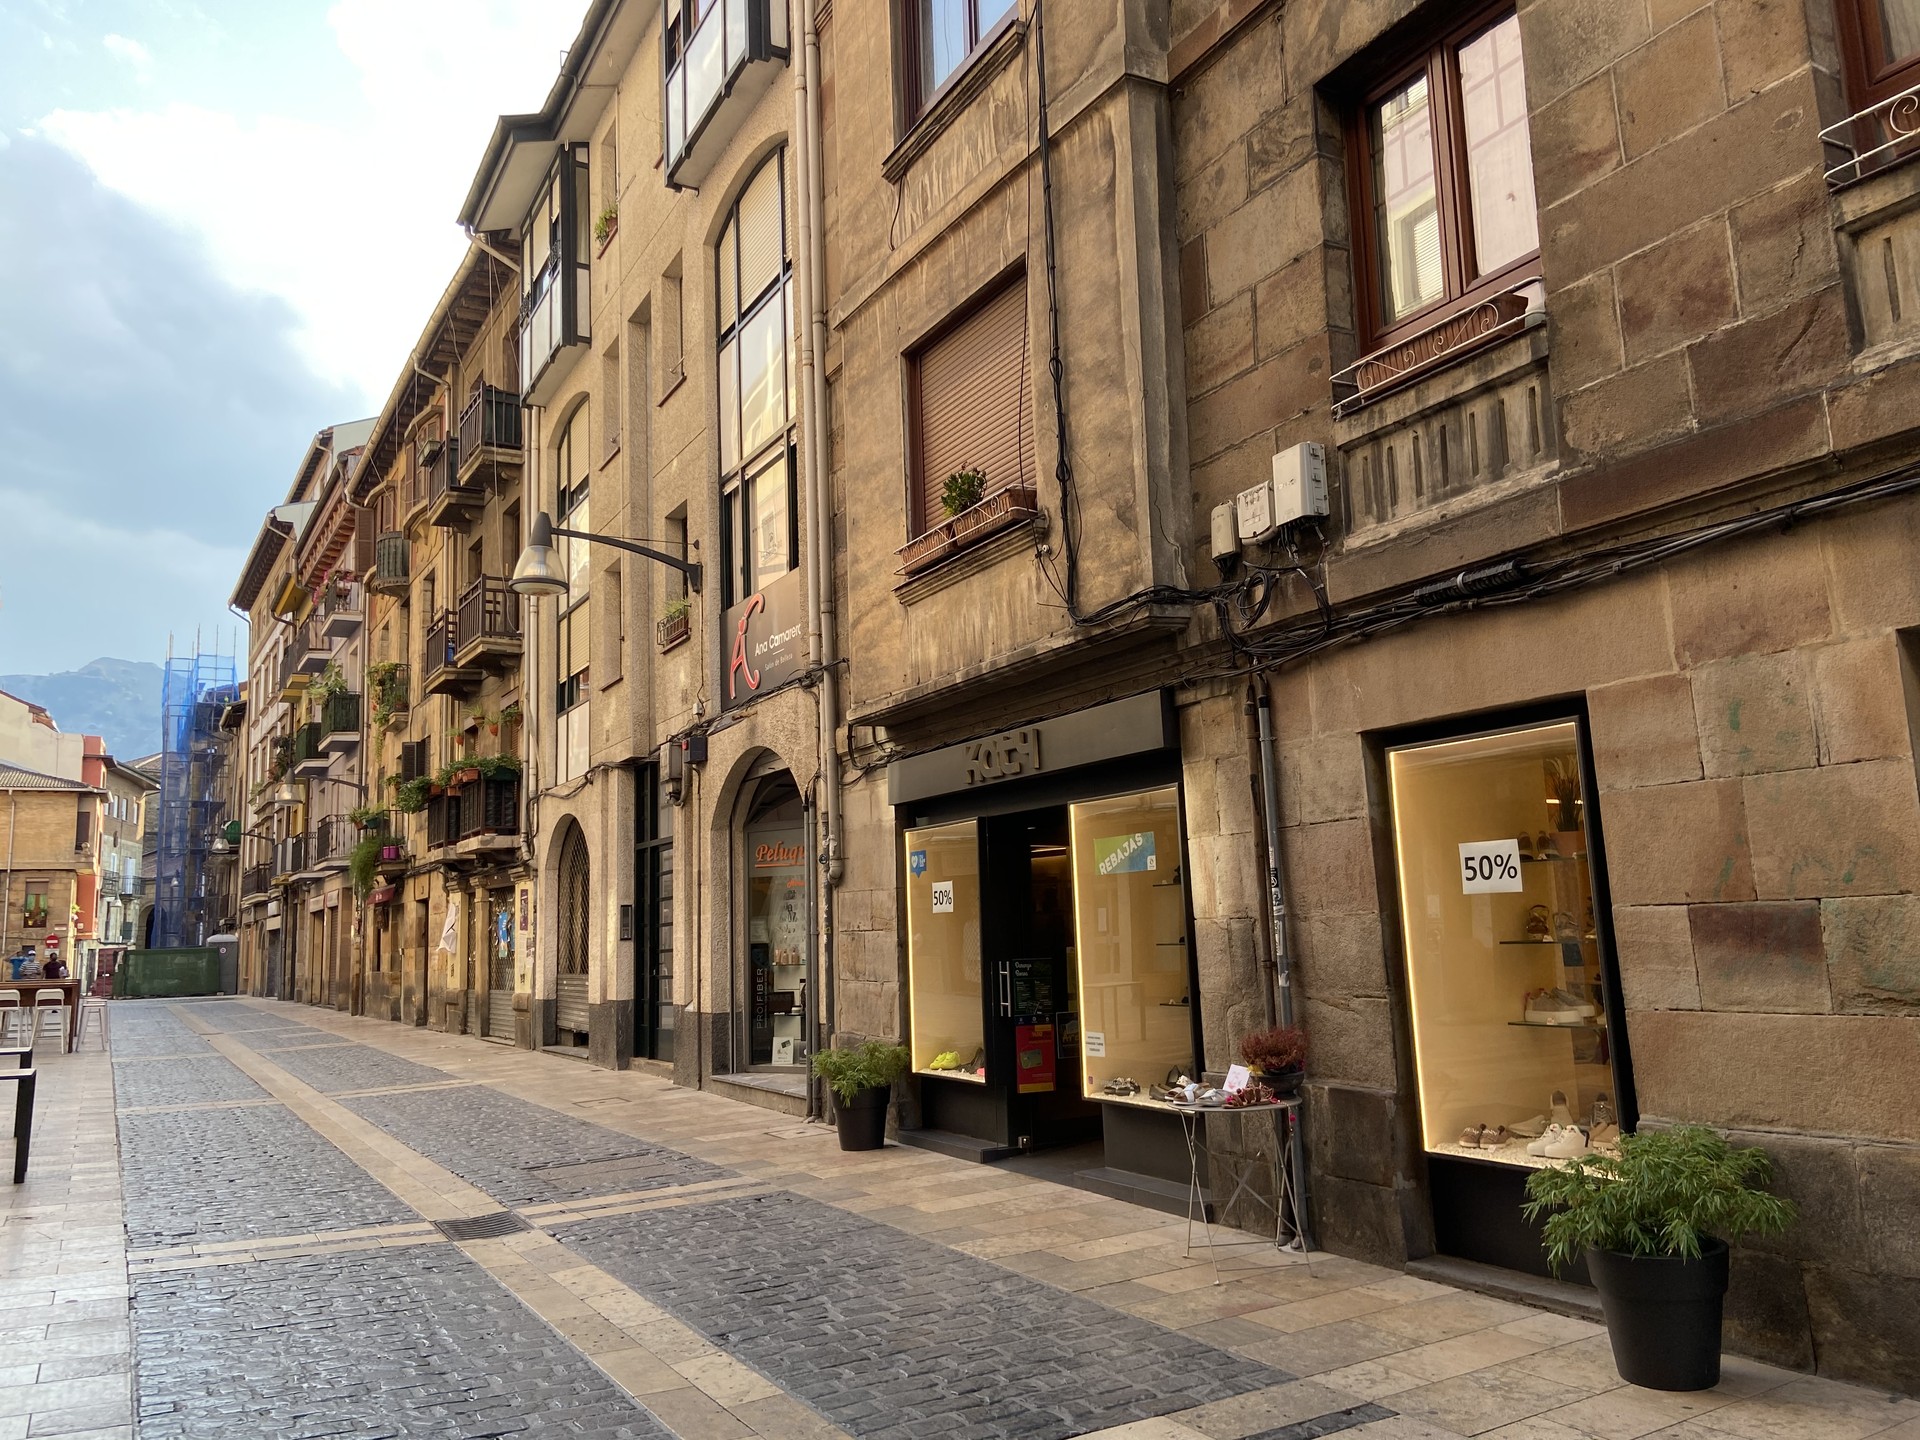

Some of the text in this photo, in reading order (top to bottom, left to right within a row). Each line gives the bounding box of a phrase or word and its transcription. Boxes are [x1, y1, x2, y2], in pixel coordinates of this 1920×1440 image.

[755, 642, 768, 657] Ana
[1099, 832, 1143, 875] REBAJAS
[1464, 853, 1518, 881] 50%
[933, 889, 952, 906] 50%
